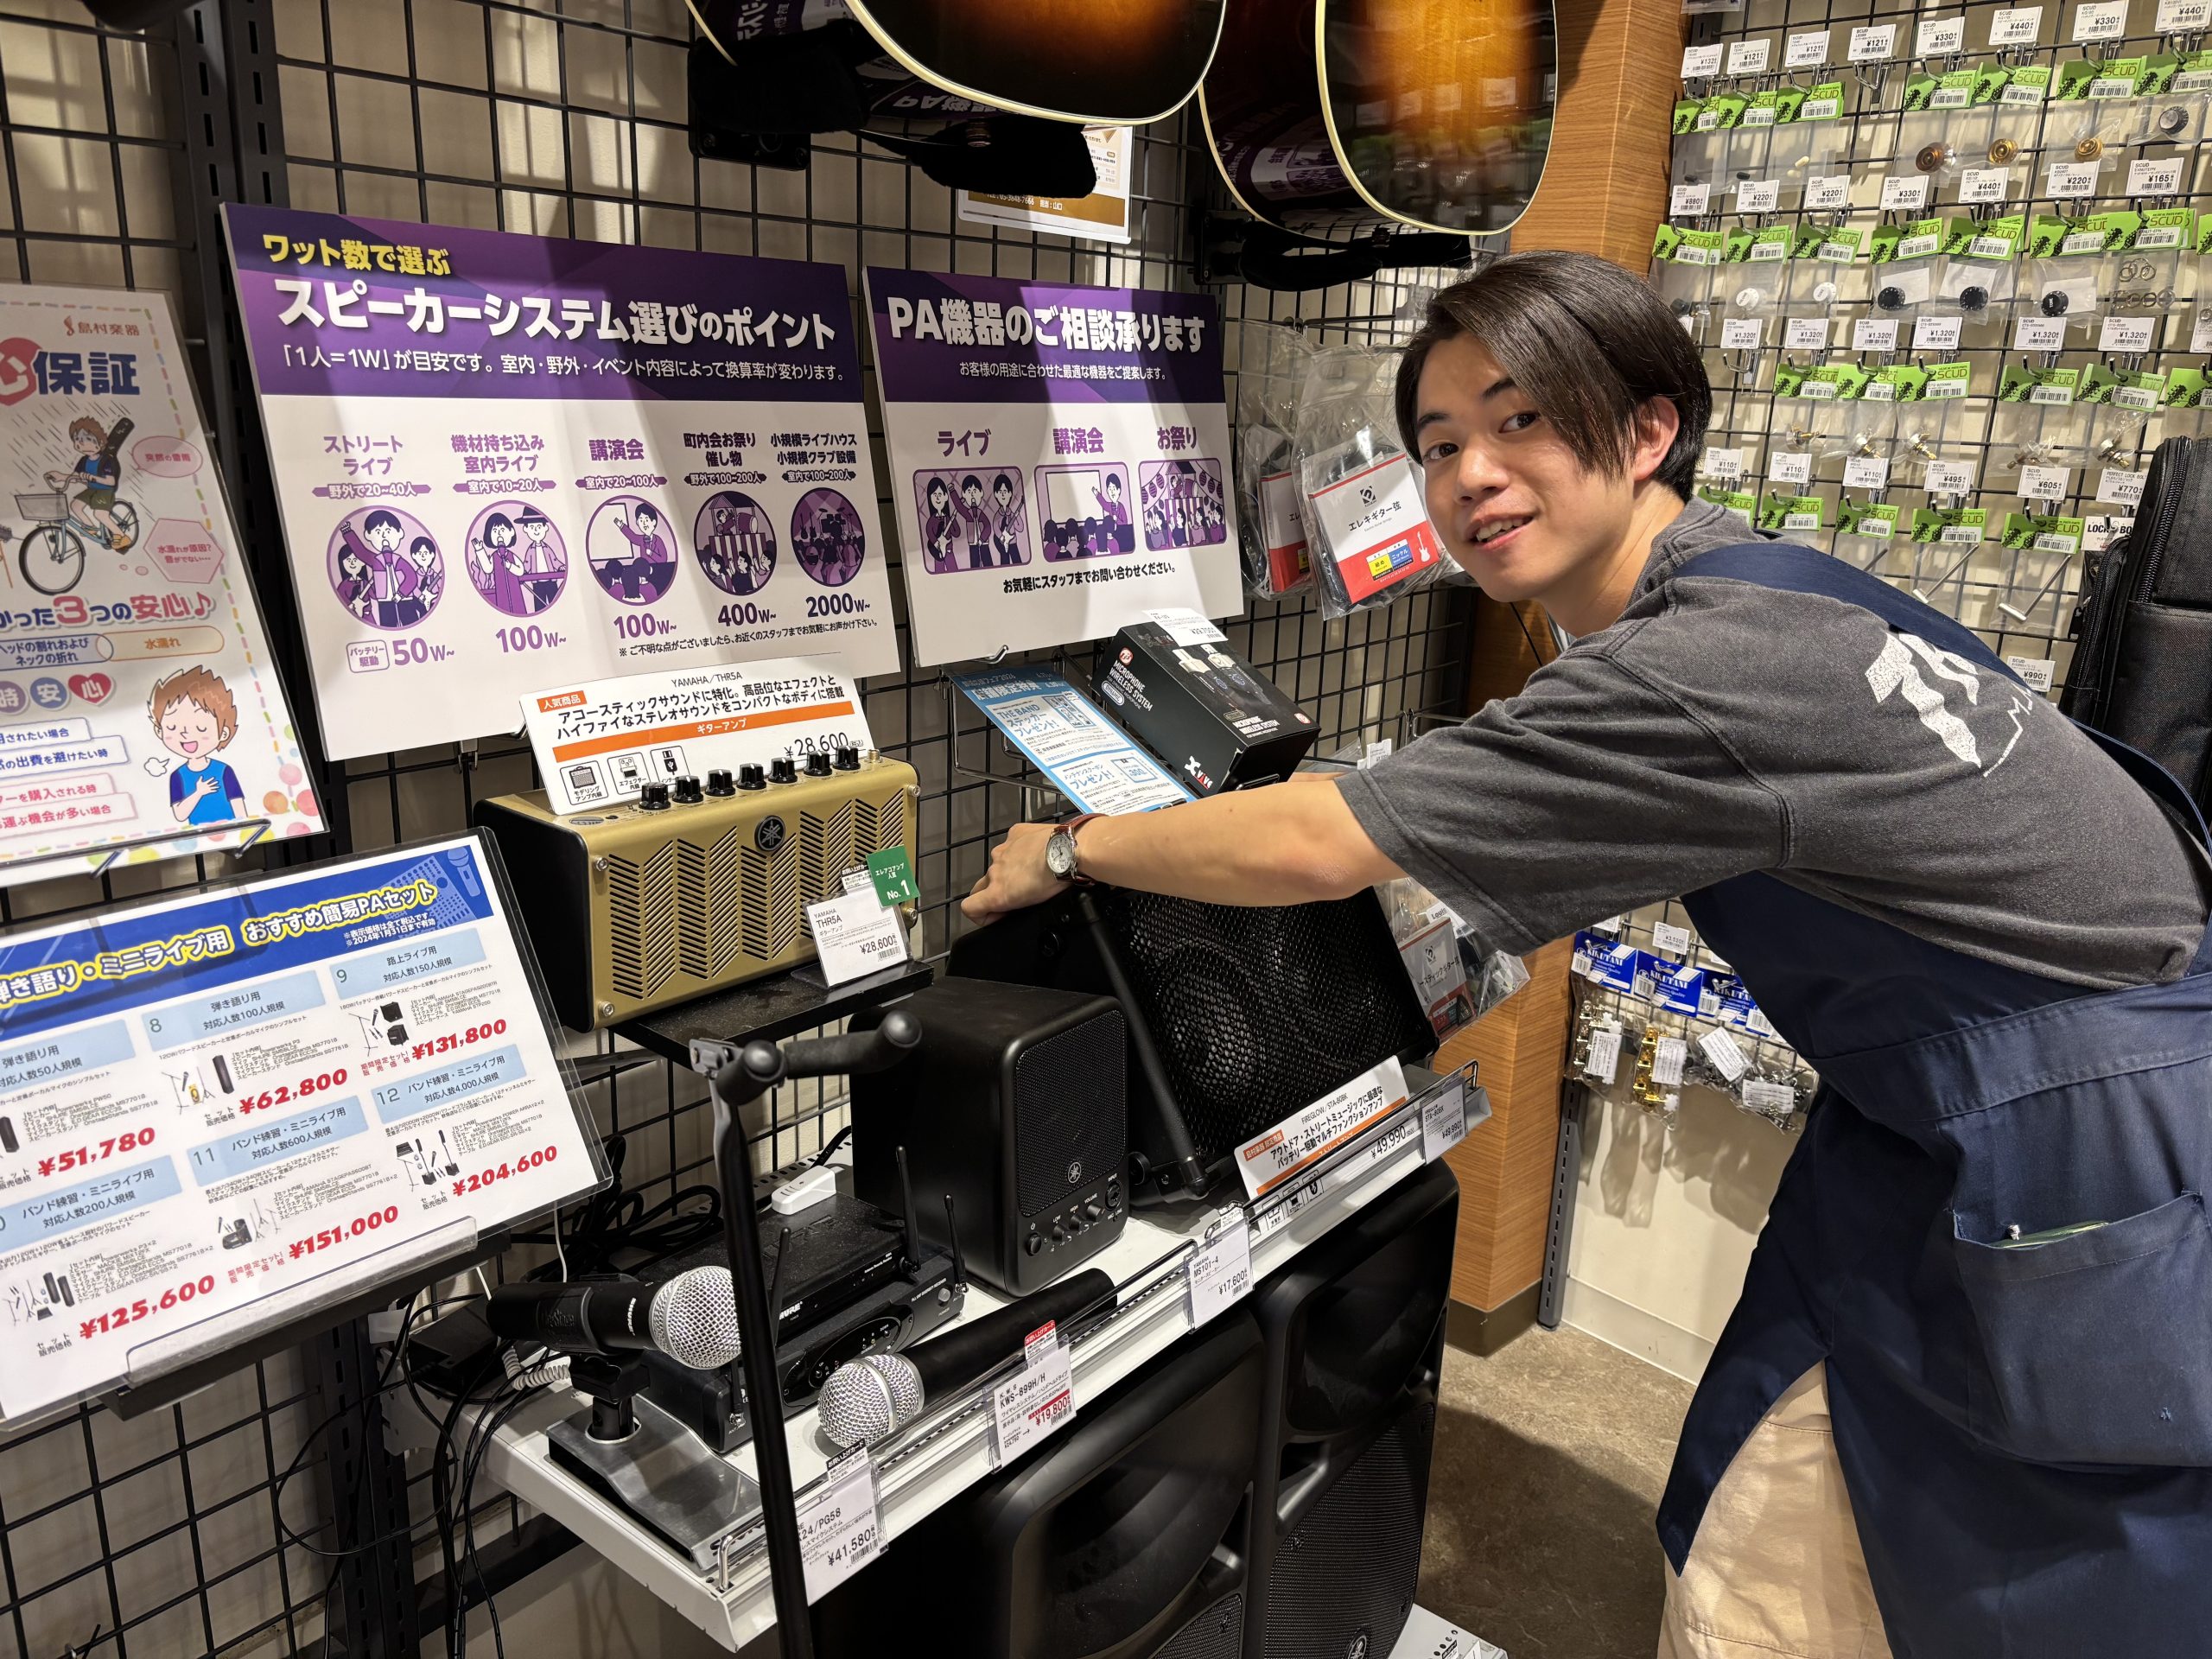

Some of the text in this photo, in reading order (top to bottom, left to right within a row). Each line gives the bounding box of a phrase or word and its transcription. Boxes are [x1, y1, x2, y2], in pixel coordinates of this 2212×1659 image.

[2094, 16, 2115, 25] ¥330
[2178, 7, 2202, 16] ¥440
[2010, 22, 2030, 31] ¥440
[1944, 78, 1972, 87] SCUD
[2017, 73, 2046, 85] SCUD
[1812, 89, 1839, 100] SCUD
[2067, 176, 2088, 185] ¥220
[2148, 175, 2170, 183] ¥165
[2150, 215, 2183, 226] SCUD
[1687, 236, 1711, 247] SCUD
[1760, 232, 1786, 243] SCUD
[1832, 233, 1858, 245] SCUD
[1986, 228, 2018, 239] SCUD
[263, 233, 452, 276] ワット数で選ぶ
[274, 277, 836, 351] スピーカーシステム選びのポイント
[78, 322, 139, 335] 島村楽器
[887, 296, 1205, 353] PA機器のご相談承ります
[959, 361, 1166, 381] お客様の用途に合わせた最適な機器をご提案します。
[1937, 368, 1967, 378] SCUD
[2044, 375, 2075, 385] SCUD
[324, 435, 403, 454] ストリート
[451, 435, 544, 453] 機材持ち込み
[683, 432, 756, 448] 町内会お祭り
[770, 433, 857, 448] 小規模ライブハウス
[938, 429, 991, 457] ライブ
[1052, 427, 1104, 454] 講演会
[1157, 427, 1198, 451] お祭り
[589, 438, 645, 461] 講演会
[705, 451, 743, 467] 催し物
[777, 450, 856, 465] 小規模クラブ設備
[343, 457, 393, 476] ライブ
[464, 454, 538, 474] 室内ライブ
[2118, 485, 2139, 494] ¥770
[1728, 499, 1752, 509] SCUD
[1348, 500, 1402, 532] エレキギター弦
[1870, 511, 1896, 520] SCUD
[2047, 523, 2080, 533] SCUD
[1391, 549, 1408, 561] ニッケル
[1003, 565, 1176, 594] お気軽にスタッフまでお問い合わせください。
[16, 652, 79, 667] ネックの折れ
[350, 646, 385, 656] バッテリー
[359, 655, 379, 667] 駆動
[1113, 660, 1146, 692] MICROPHONE
[2024, 671, 2043, 680] ¥990
[1109, 667, 1153, 712] WIRELESS SYSTEM
[543, 695, 582, 710] 人気商品
[557, 674, 836, 725] アコースティックサウンドに特化。高品位なエフェクトと
[556, 685, 845, 740] ハイファイなステレオサウンドをコンパクトなボディに搭載
[996, 704, 1040, 719] THE BAND
[1007, 714, 1047, 728] ステッカー
[697, 718, 747, 734] ギターアンプ
[1014, 720, 1059, 736] プレゼント!
[574, 786, 600, 796] モデリング
[620, 777, 646, 786] エフェクター
[875, 862, 905, 876] エレアコアンプ
[887, 879, 910, 899] No. 1
[245, 882, 436, 942] おすすめ簡易PAセット
[814, 908, 837, 919] YAMAHA
[816, 914, 842, 929] THR5A
[860, 935, 893, 954] ¥28,600
[387, 945, 437, 967] 路上ライブ用
[336, 969, 347, 983] 9
[383, 957, 453, 982] 対応人数150人規模
[211, 992, 261, 1013] 弾き語り用
[203, 1001, 285, 1030] 対応人数100人規模
[149, 1018, 162, 1033] 8
[412, 1019, 507, 1060] ¥131,800
[3, 1046, 60, 1068] 弾き語り用
[408, 1055, 505, 1093] バンド練習・ミニライブ用
[239, 1068, 348, 1115] ¥62,800
[377, 1087, 401, 1105] 12
[424, 1071, 500, 1103] 対応人数4,000人規模
[232, 1107, 346, 1151] バンド練習・ミニライブ用
[1270, 1085, 1383, 1160] アウトドア・ストリートミュージックに最適な
[251, 1126, 333, 1160] 対応人数600人規模
[1277, 1098, 1383, 1169] バッテリー駆動マルチファンクションアンプ
[1370, 1126, 1407, 1160] ¥49,990
[38, 1128, 156, 1177] ¥51,780
[193, 1147, 215, 1166] 11
[453, 1146, 557, 1197] ¥204,600
[22, 1168, 155, 1218] バンド練習・ミニライブ用
[43, 1190, 137, 1229] 対応人数200人規模
[289, 1205, 398, 1260] ¥151,000
[1219, 1270, 1244, 1294] ¥17,600
[79, 1274, 215, 1339] ¥125,600
[779, 1301, 802, 1319] URE
[1000, 1373, 1046, 1408] KWS-899H/H
[1036, 1397, 1067, 1426] ¥19,800
[828, 1442, 864, 1468] お買い上げカード
[827, 1529, 871, 1566] ¥41,580
